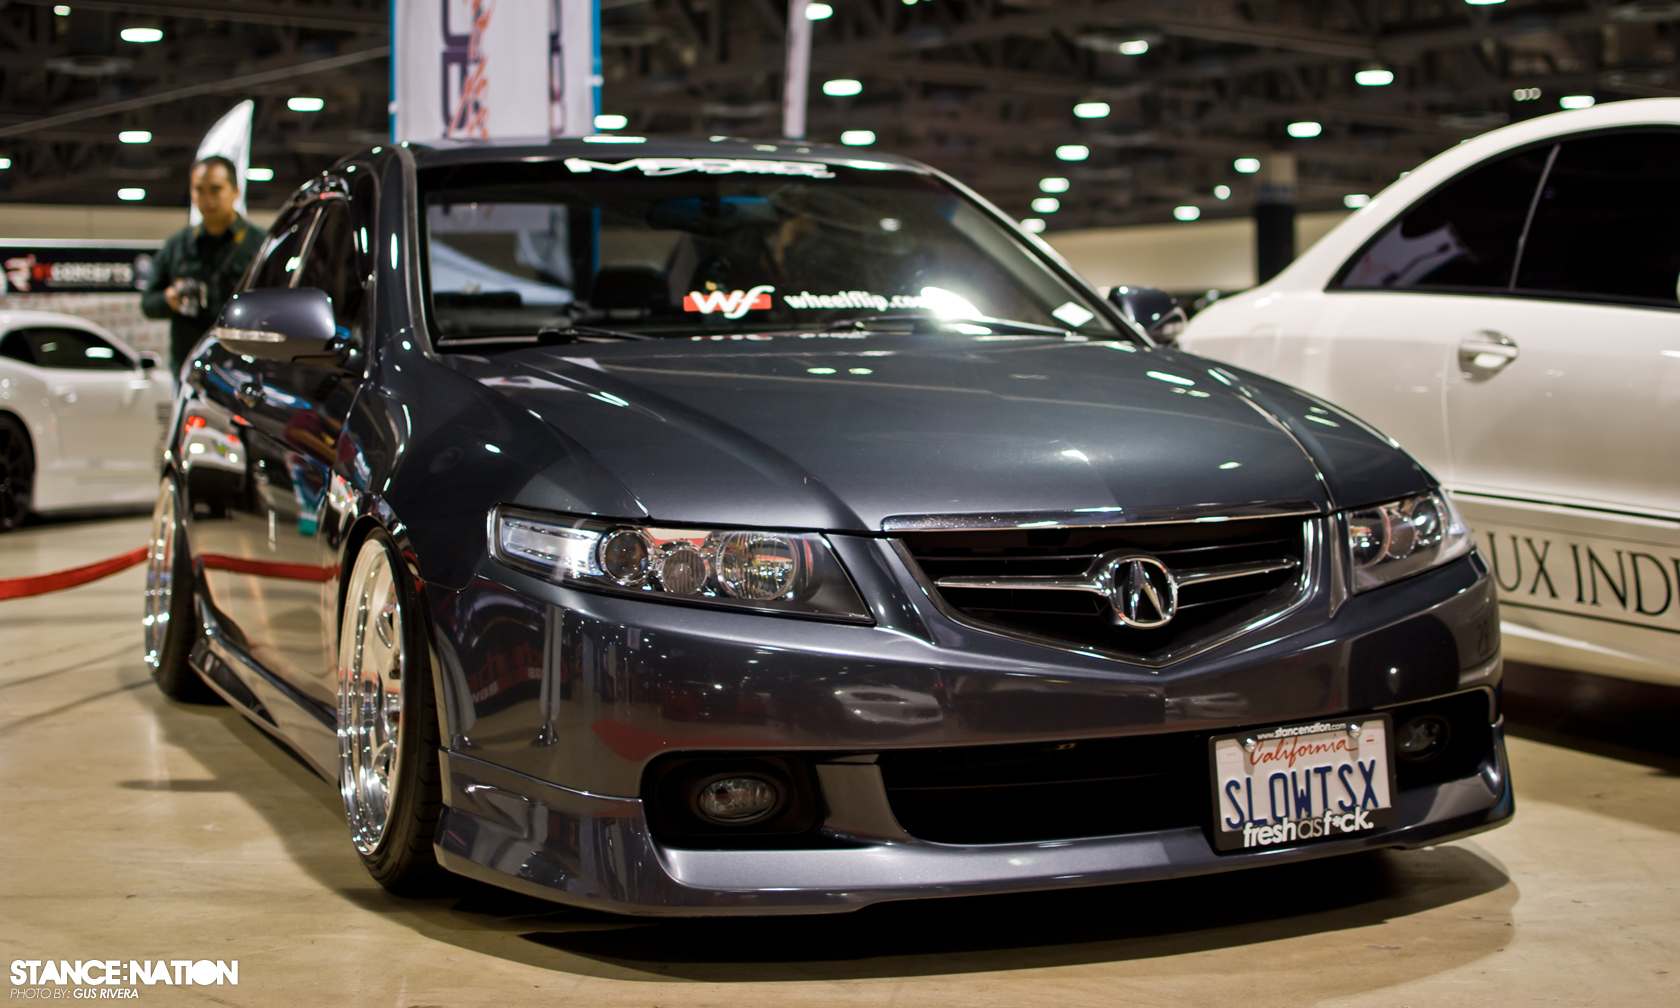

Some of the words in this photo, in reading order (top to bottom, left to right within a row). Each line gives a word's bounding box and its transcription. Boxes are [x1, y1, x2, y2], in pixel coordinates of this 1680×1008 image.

[1474, 530, 1558, 598] UX
[1570, 543, 1680, 616] IND
[1257, 723, 1346, 740] www.stancenation.com
[1249, 737, 1359, 768] California
[1225, 759, 1379, 829] SLOWTSX
[1243, 817, 1296, 847] fresh
[1298, 818, 1323, 839] as
